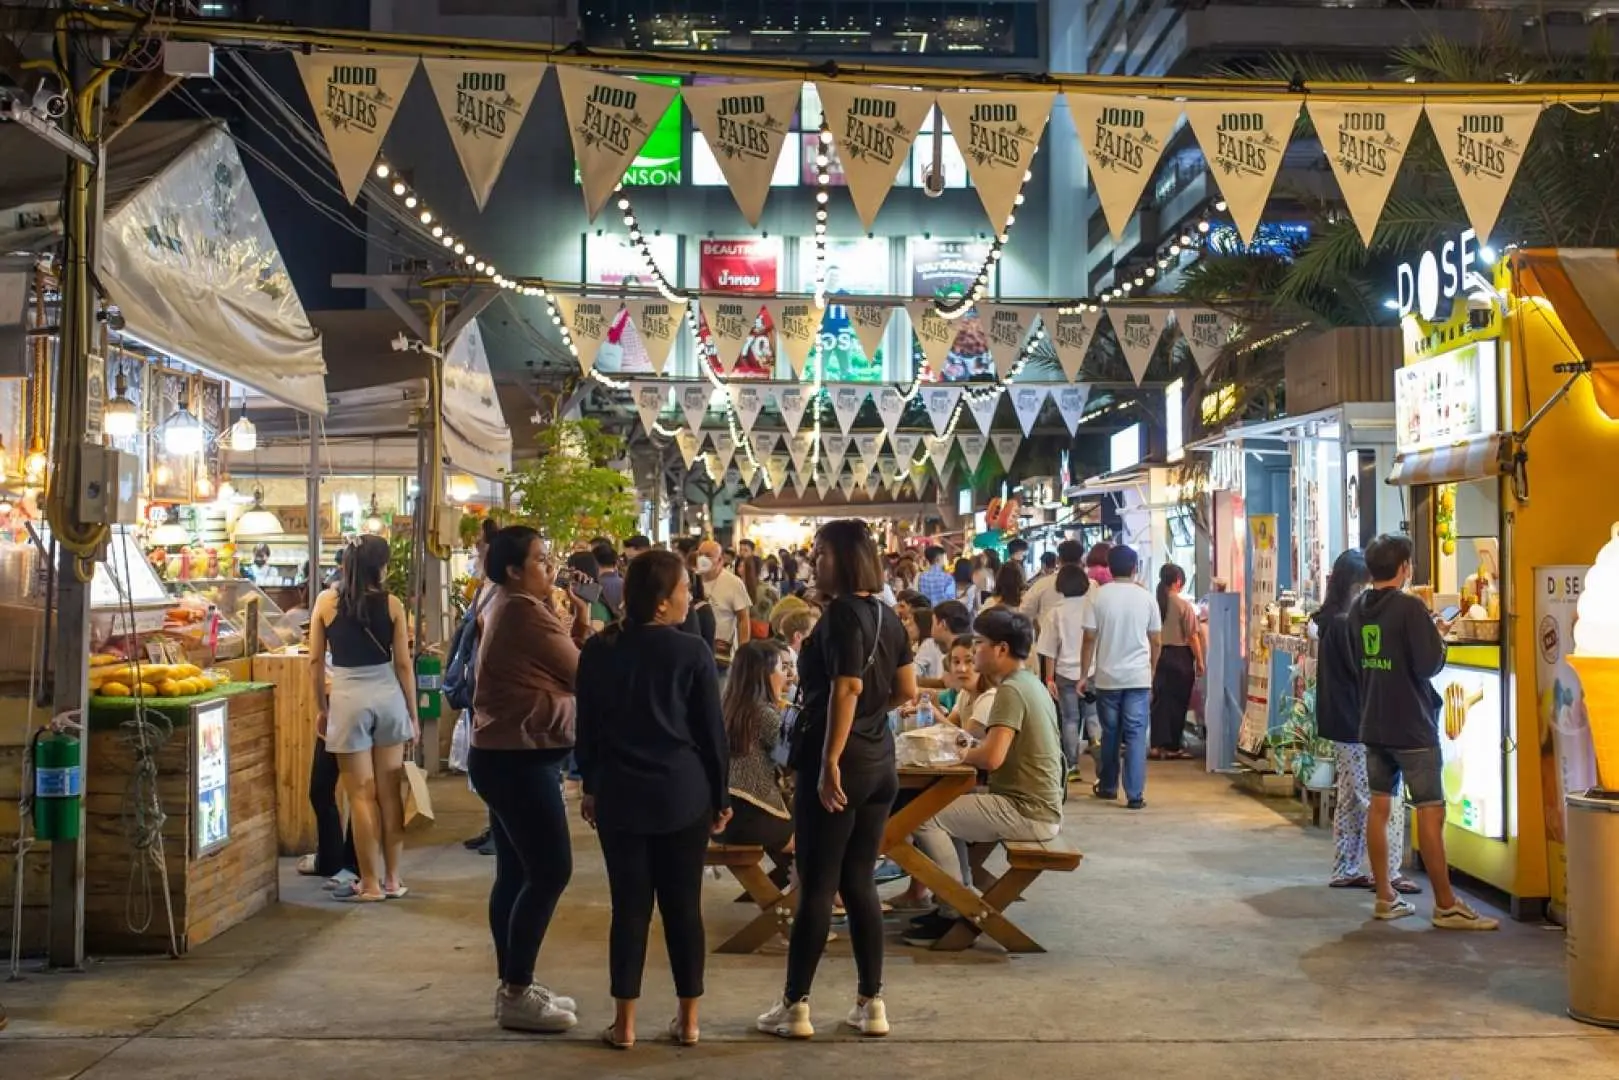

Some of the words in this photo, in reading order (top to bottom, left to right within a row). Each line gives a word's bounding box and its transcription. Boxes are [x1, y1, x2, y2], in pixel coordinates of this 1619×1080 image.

[327, 65, 377, 86] JODD
[457, 71, 506, 92] JODD
[326, 84, 377, 128] FAIRS
[586, 85, 636, 109] JODD
[717, 95, 765, 116] JODD
[847, 96, 896, 119] JODD
[456, 90, 506, 134] FAIRS
[969, 103, 1017, 123] JODD
[1096, 106, 1144, 128] JODD
[1216, 113, 1264, 132] JODD
[1339, 112, 1385, 131] JODD
[1457, 114, 1505, 134] JODD
[583, 103, 631, 151] FAIRS
[717, 115, 768, 154] FAIRS
[845, 116, 894, 159] FAIRS
[969, 121, 1019, 163] FAIRS
[1095, 125, 1143, 169] FAIRS
[1216, 131, 1267, 171] FAIRS
[1338, 130, 1386, 172] FAIRS
[1456, 132, 1505, 174] FAIRS
[574, 168, 681, 185] RNSON
